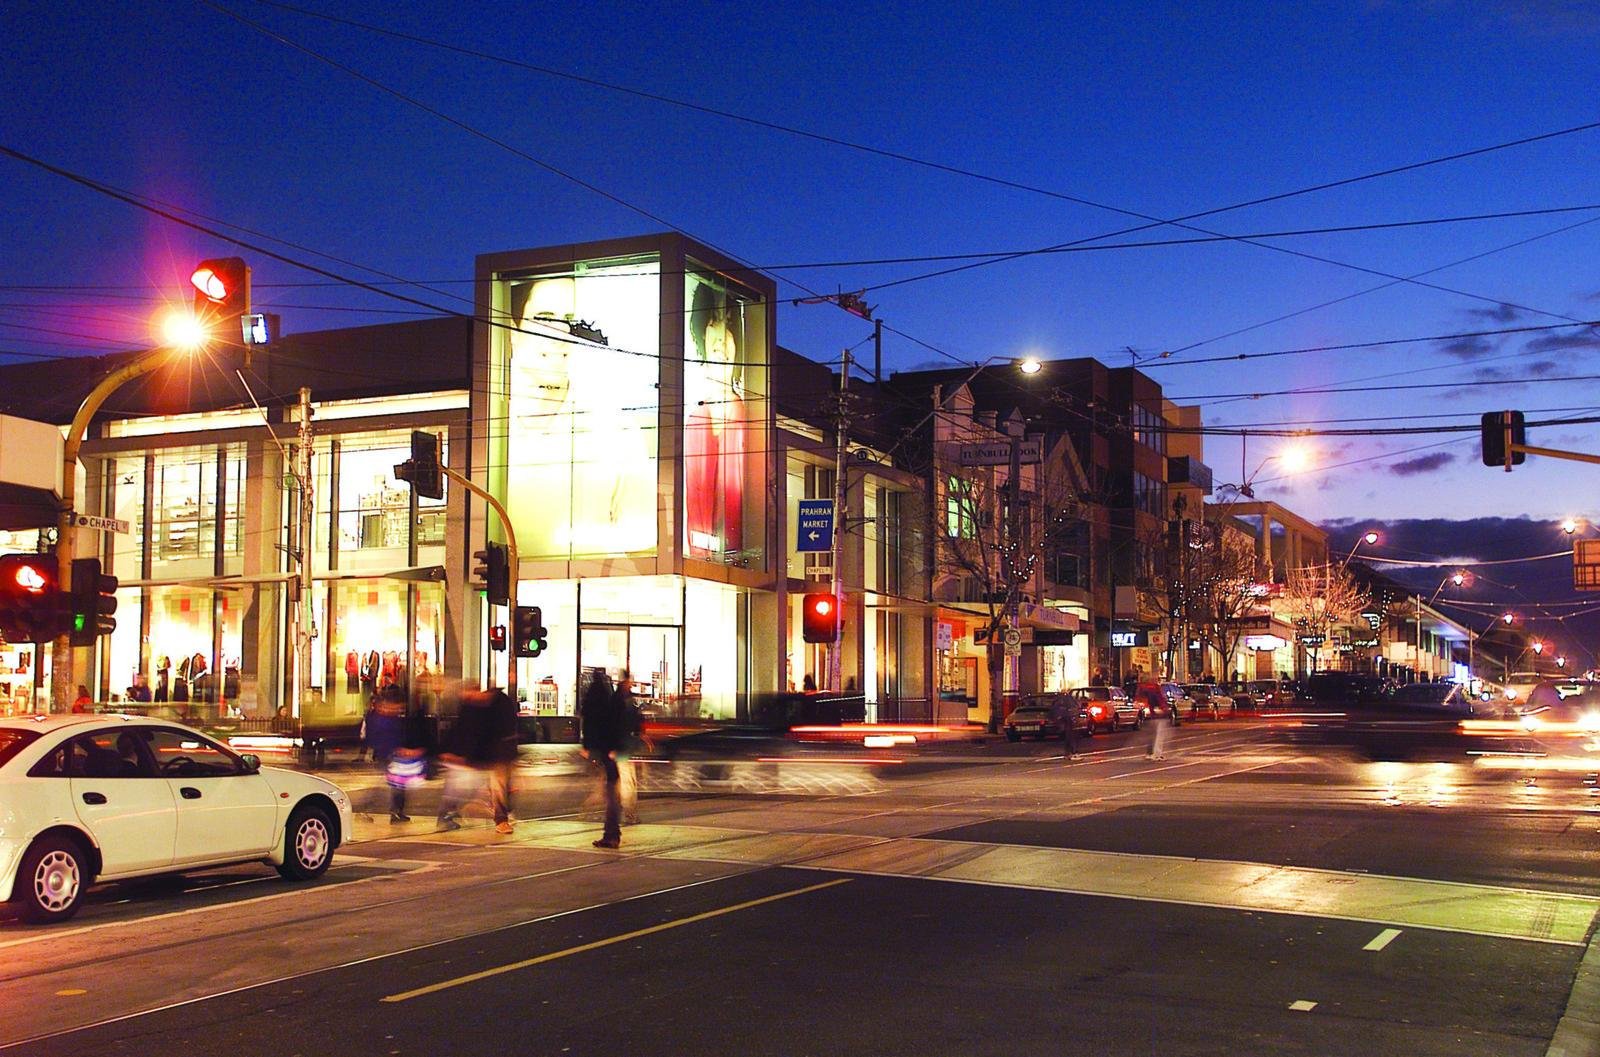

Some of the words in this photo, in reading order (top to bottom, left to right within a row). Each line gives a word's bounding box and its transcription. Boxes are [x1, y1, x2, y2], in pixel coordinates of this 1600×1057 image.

[1018, 447, 1038, 456] OOK
[801, 508, 832, 516] PRAHRAN
[90, 518, 120, 531] CHAPEL
[803, 520, 829, 529] MARKET
